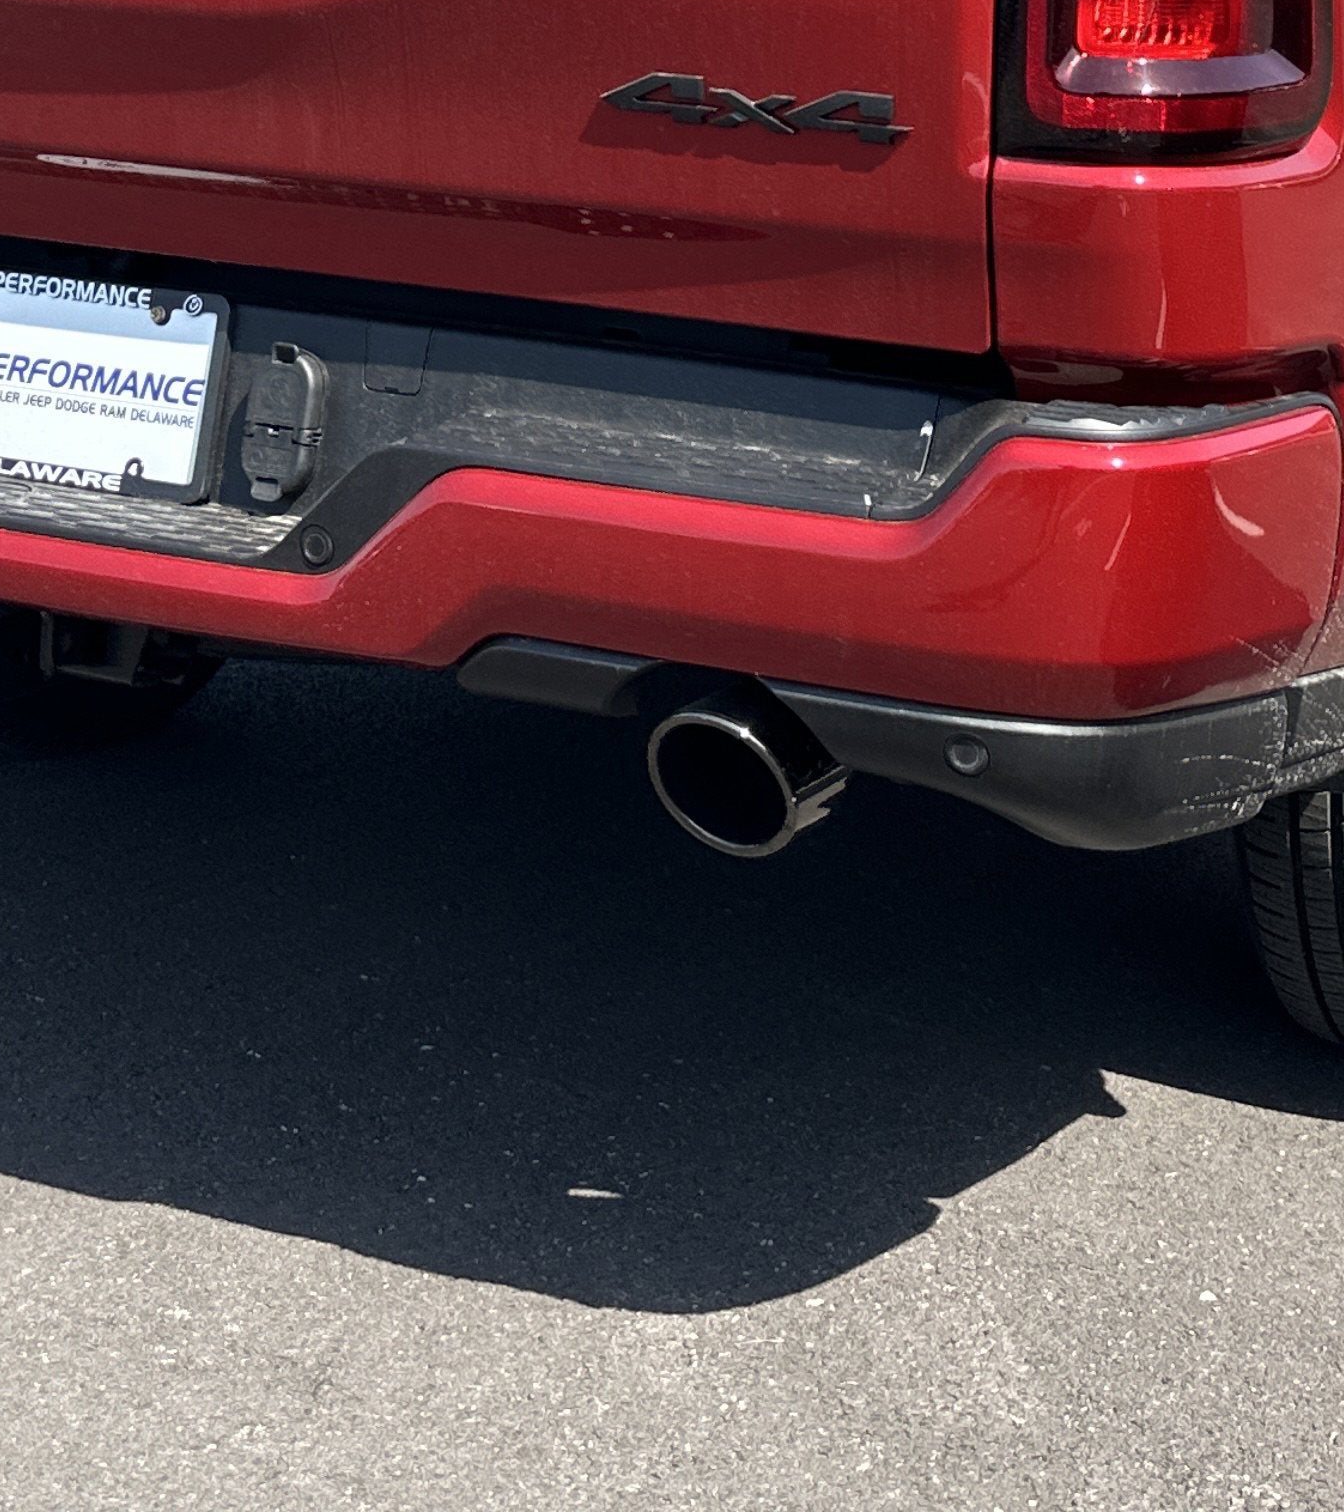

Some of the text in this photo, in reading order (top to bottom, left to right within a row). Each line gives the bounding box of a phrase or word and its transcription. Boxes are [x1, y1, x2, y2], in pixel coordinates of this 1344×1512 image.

[23, 393, 52, 409] JEEP
[55, 396, 96, 415] DODGE
[100, 404, 127, 420] RAM
[130, 408, 195, 430] DELAWARE
